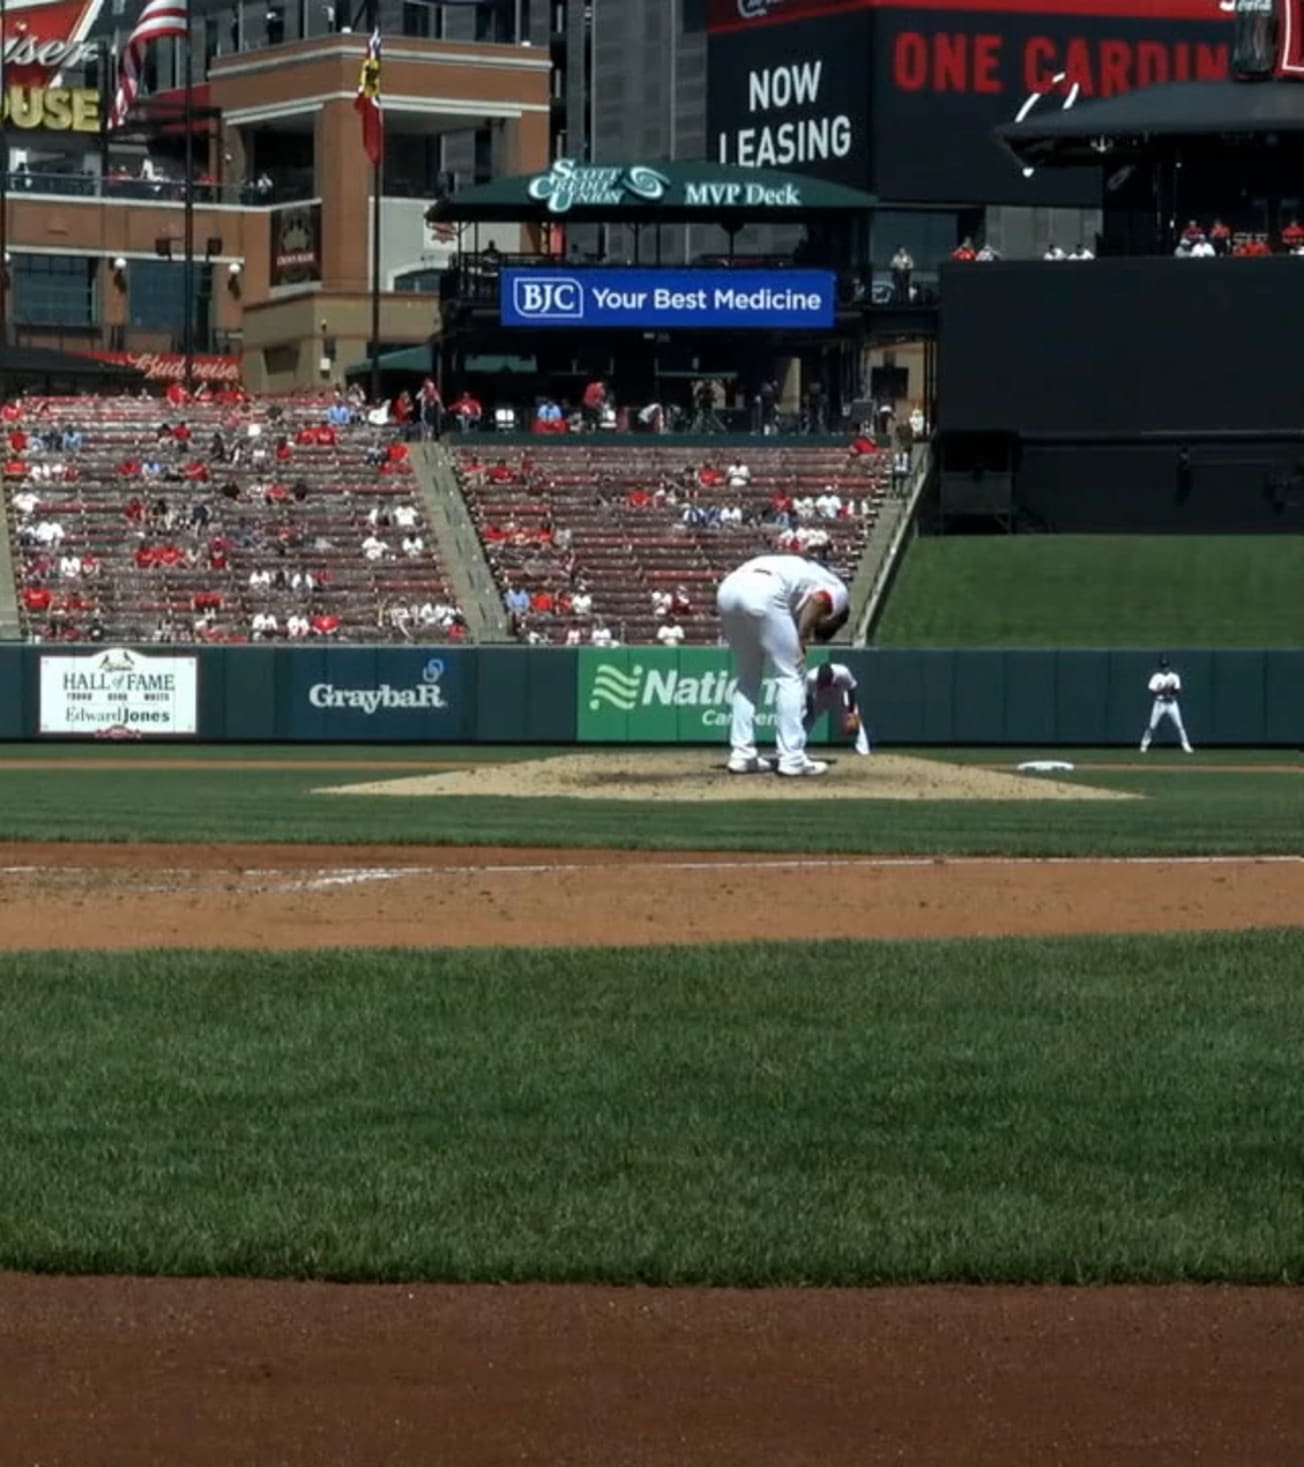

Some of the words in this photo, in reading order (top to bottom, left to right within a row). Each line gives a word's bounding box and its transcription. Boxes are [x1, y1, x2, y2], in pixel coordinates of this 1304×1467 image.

[894, 31, 1004, 94] ONE
[749, 60, 822, 112] NOW
[719, 115, 852, 168] LEASING
[684, 183, 740, 205] MVP
[746, 183, 801, 205] Deck
[523, 283, 575, 312] BJC
[592, 288, 646, 309] Your
[654, 288, 707, 309] Best
[714, 288, 822, 310] Medicine
[63, 673, 111, 691] HALL
[127, 673, 176, 691] FAME
